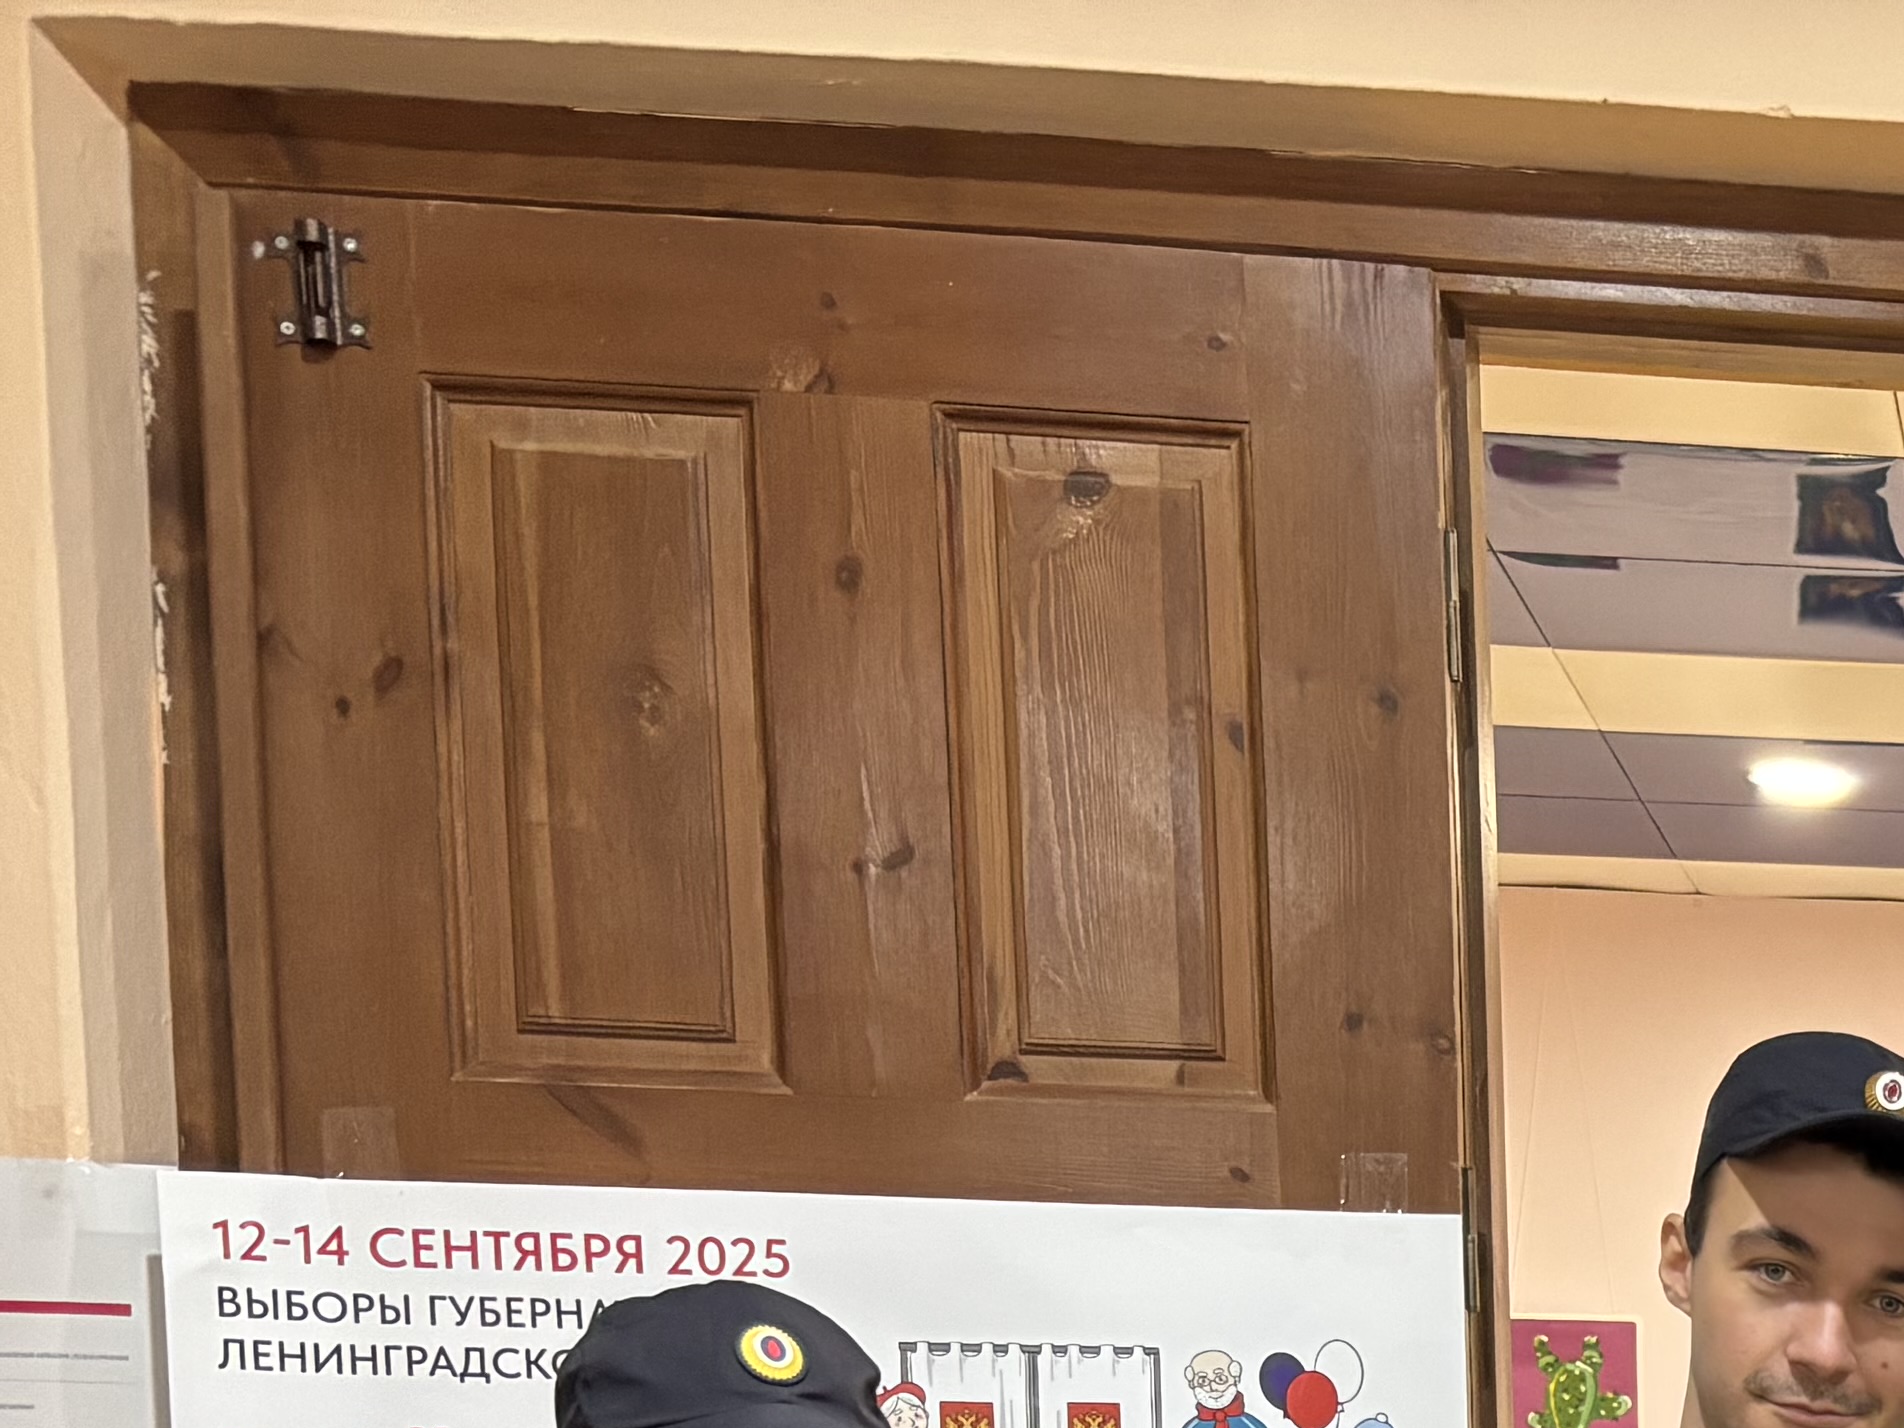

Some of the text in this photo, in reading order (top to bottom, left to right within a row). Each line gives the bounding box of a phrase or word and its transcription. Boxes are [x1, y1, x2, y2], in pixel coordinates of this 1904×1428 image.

[212, 1219, 792, 1279] 12-14 СЕНТЯБРЯ 2025
[216, 1285, 412, 1326] ВЫБОРЫ
